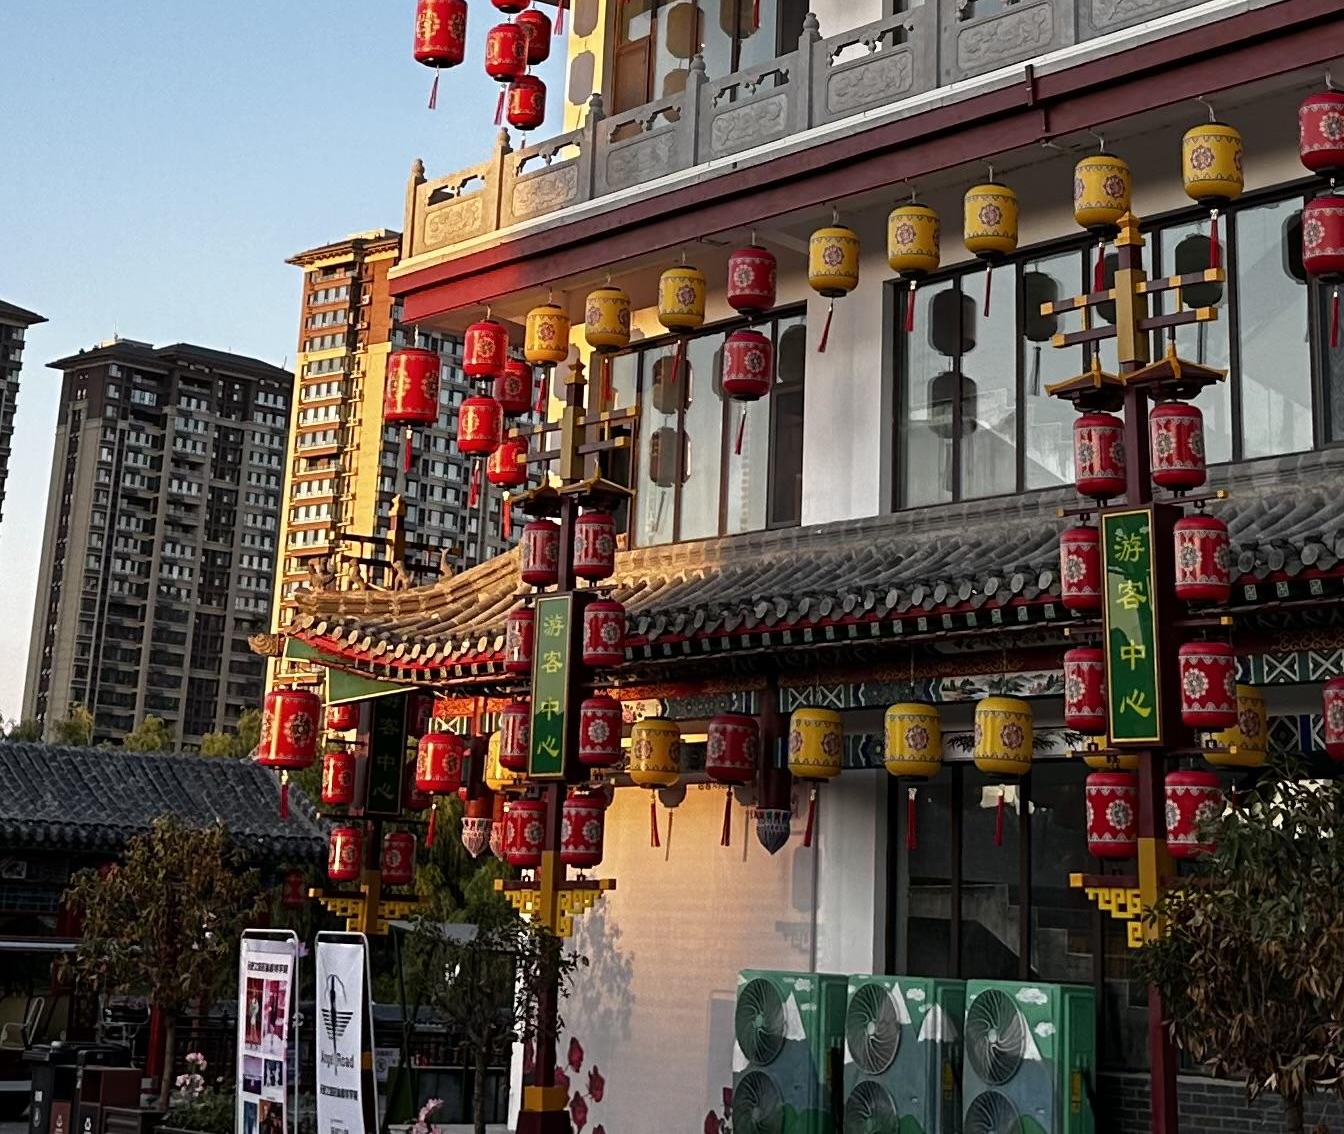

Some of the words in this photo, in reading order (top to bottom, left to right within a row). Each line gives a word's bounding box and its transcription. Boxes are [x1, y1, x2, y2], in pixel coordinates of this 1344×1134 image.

[537, 614, 565, 758] 游客中心
[1114, 533, 1152, 717] 游客中心
